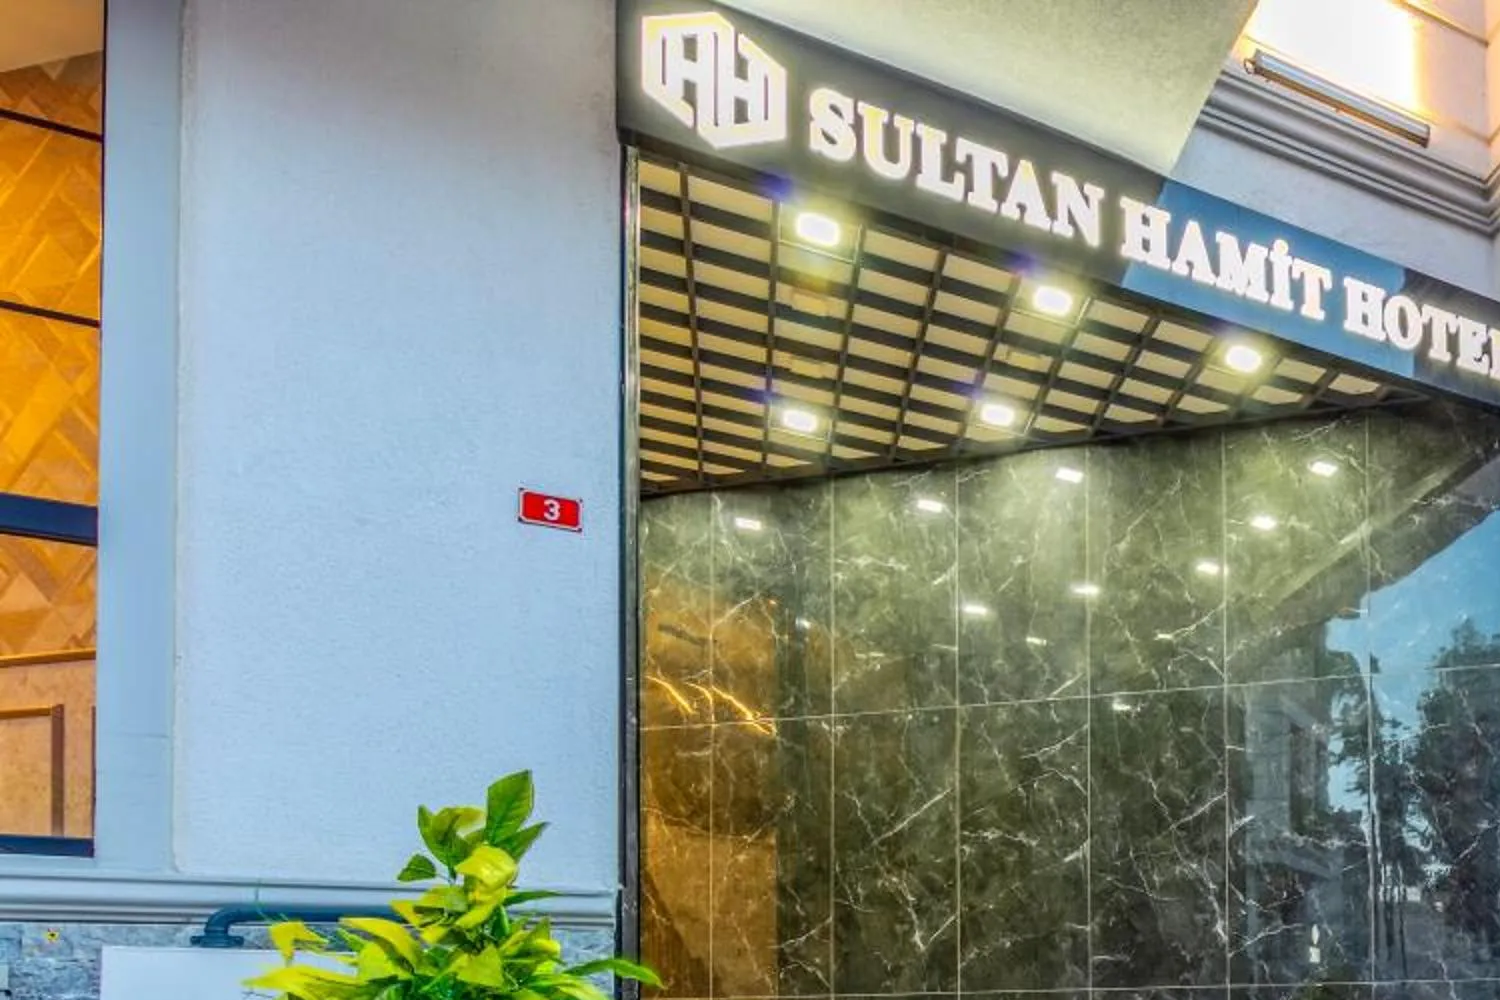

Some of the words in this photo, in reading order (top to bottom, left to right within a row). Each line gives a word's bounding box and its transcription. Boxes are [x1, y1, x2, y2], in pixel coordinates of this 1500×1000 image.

[808, 87, 1105, 247] SULTAN
[1119, 198, 1332, 321] HAMİT
[543, 499, 561, 521] 3
